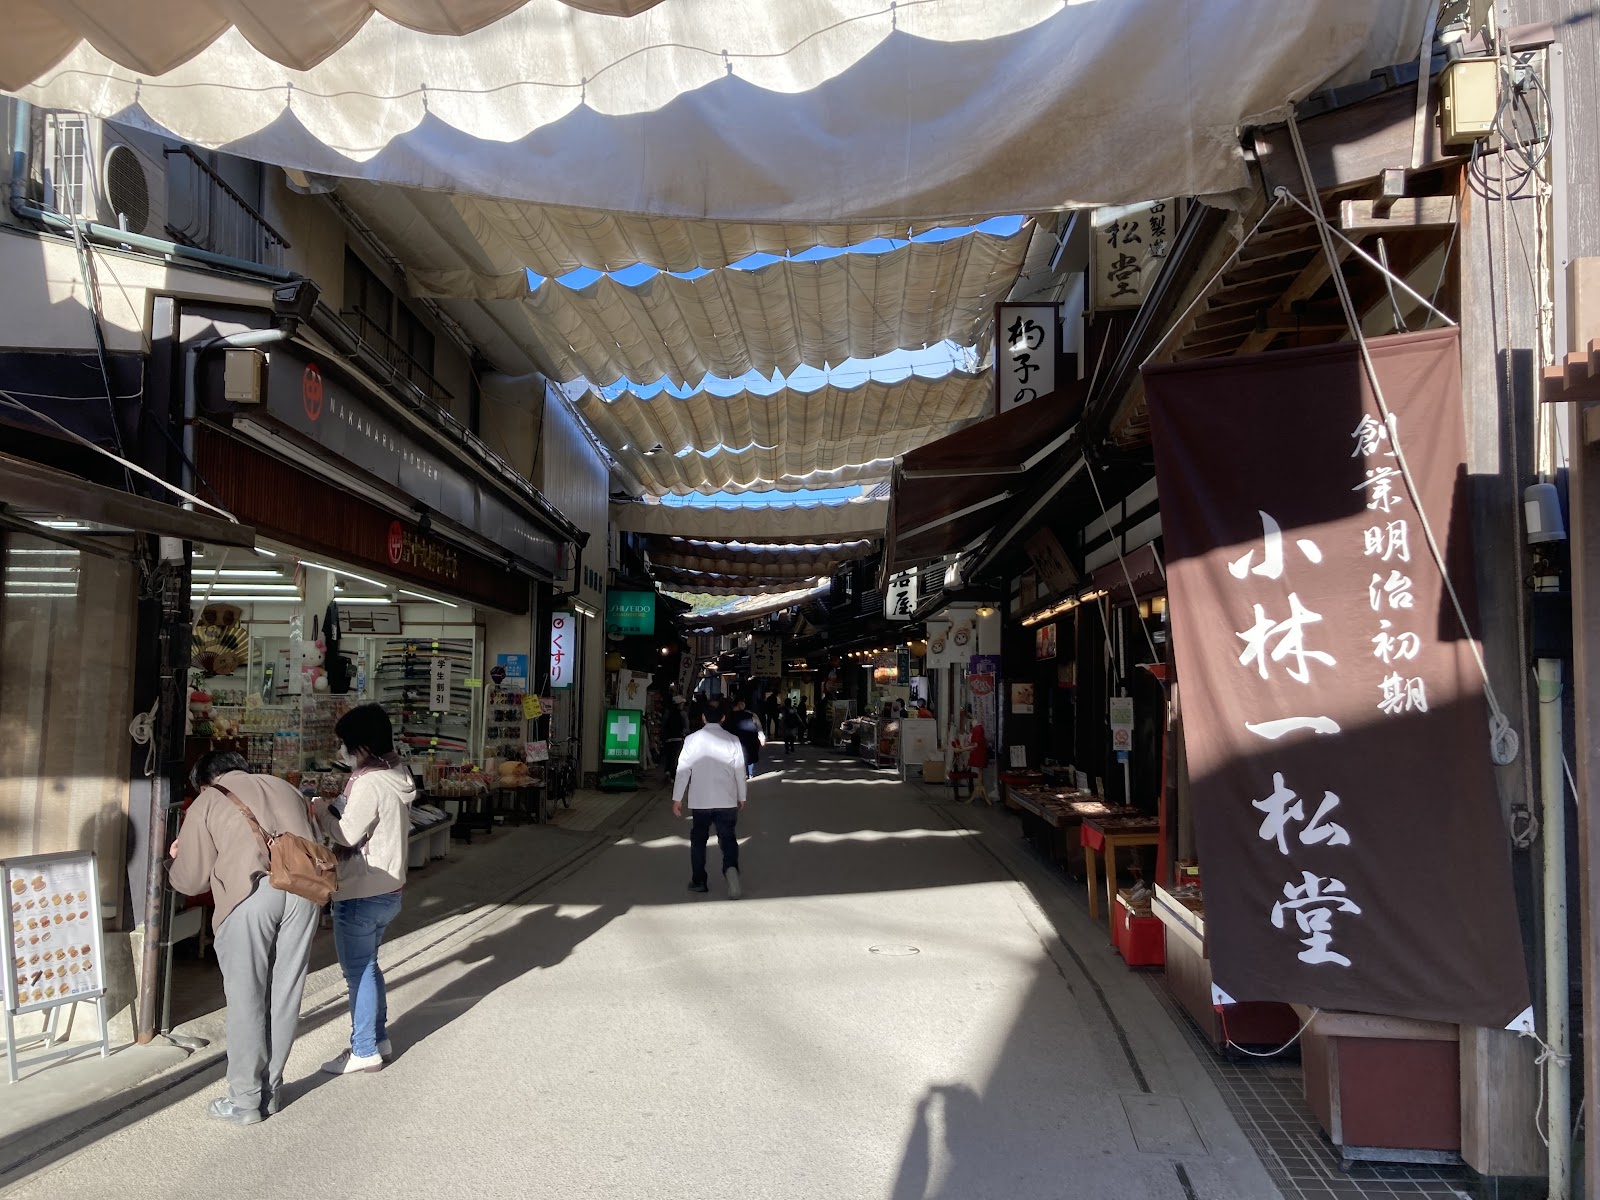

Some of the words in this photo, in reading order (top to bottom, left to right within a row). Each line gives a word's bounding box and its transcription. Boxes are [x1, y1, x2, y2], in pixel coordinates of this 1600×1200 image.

[1105, 218, 1142, 298] 松堂
[1007, 315, 1045, 402] 杓子の
[1350, 412, 1429, 715] 創業明治初期
[609, 604, 651, 613] SHISEIDO
[436, 660, 446, 703] 学生割引
[551, 633, 565, 682] くすり
[1227, 509, 1362, 967] 小林一松堂
